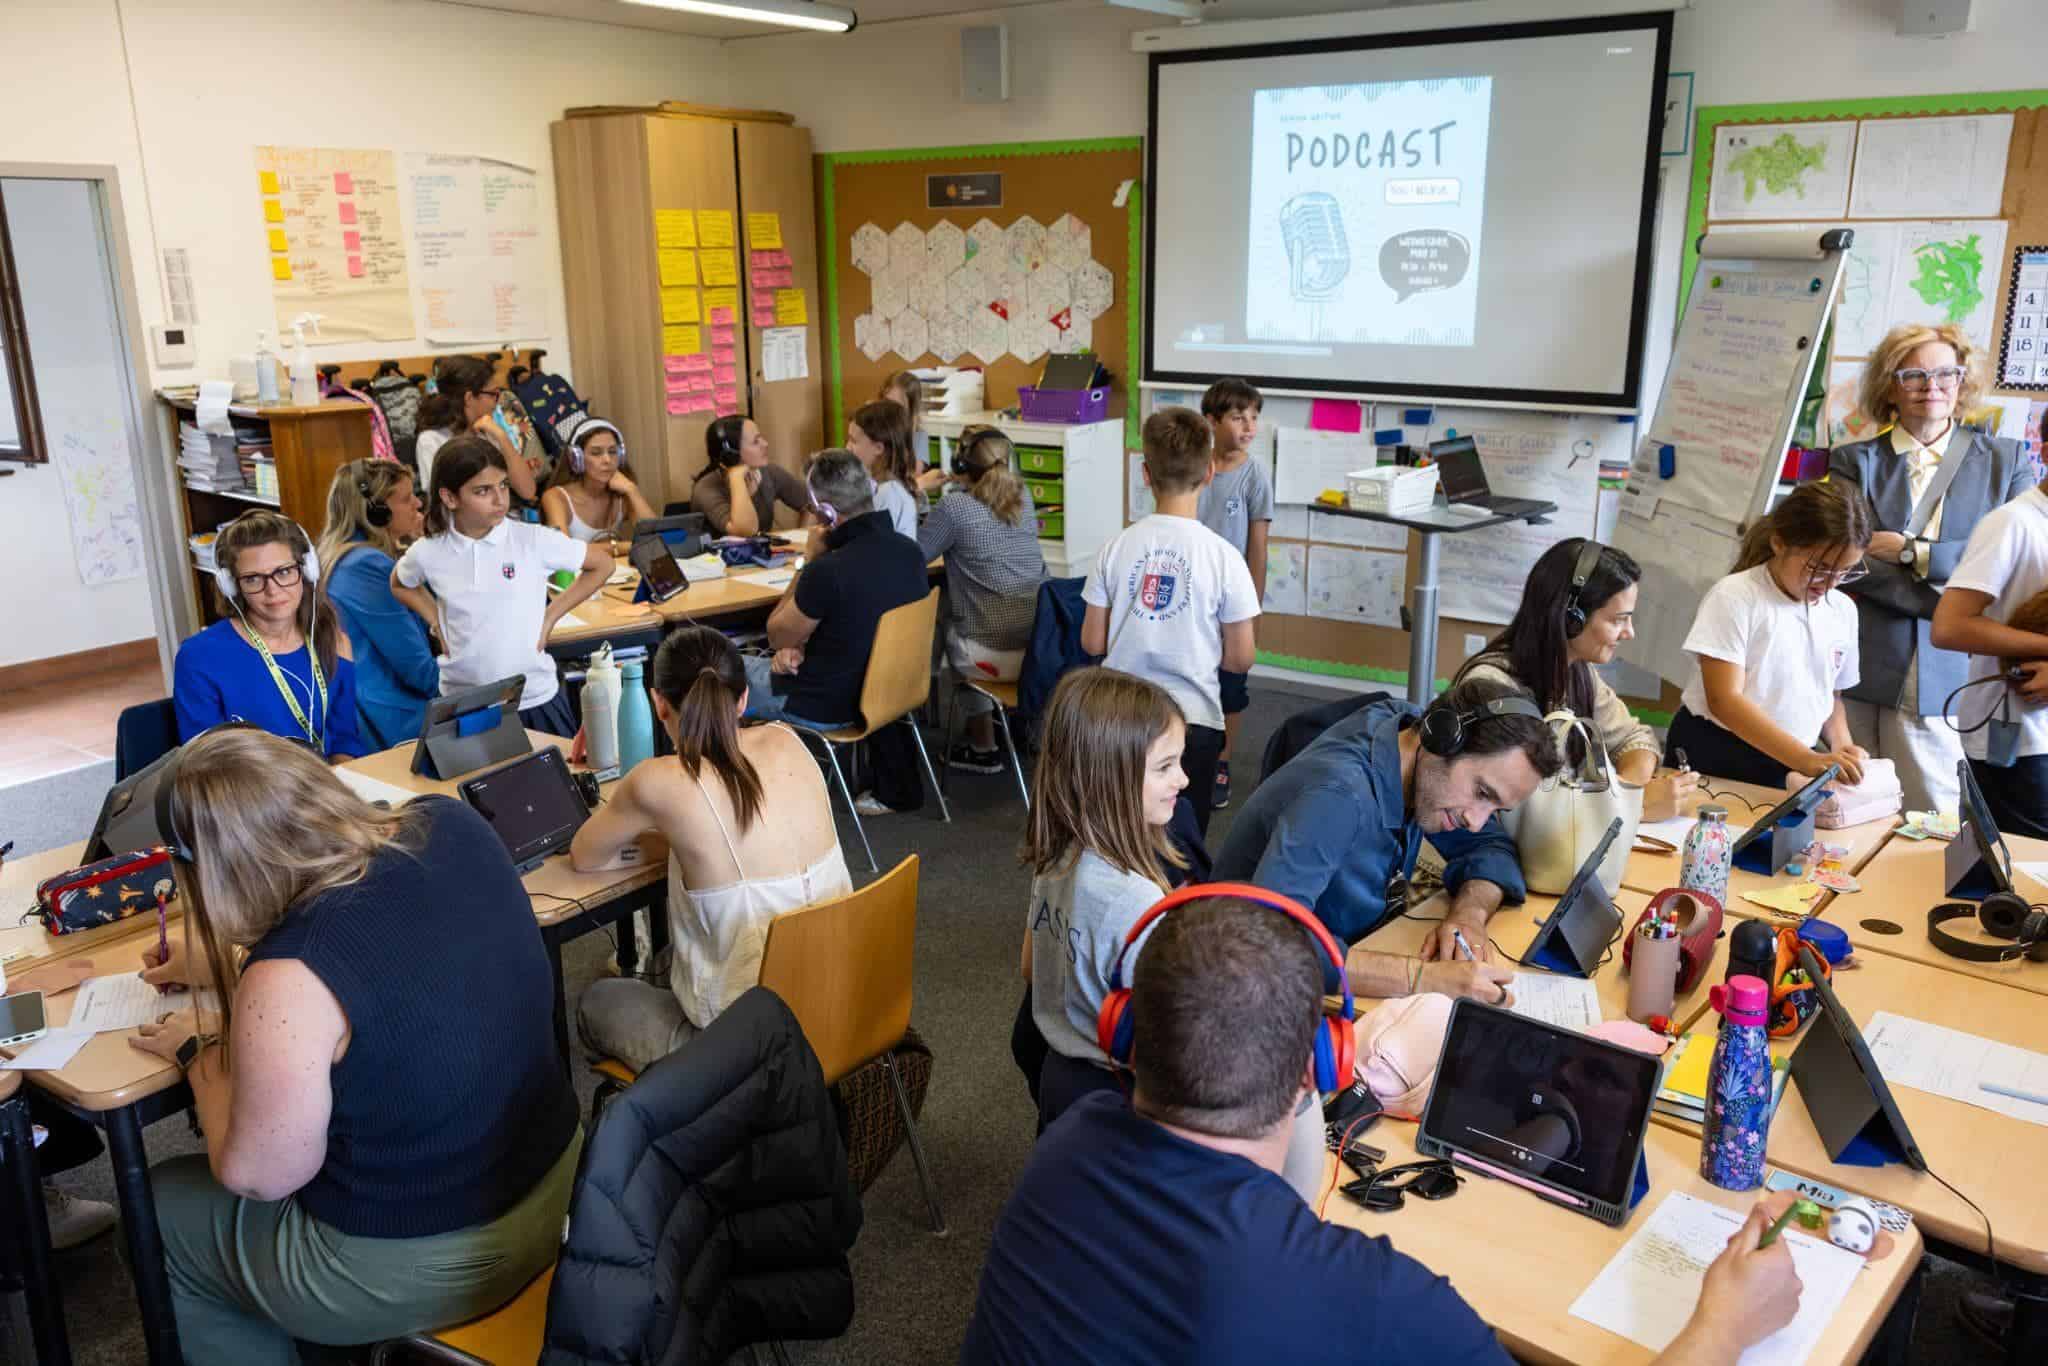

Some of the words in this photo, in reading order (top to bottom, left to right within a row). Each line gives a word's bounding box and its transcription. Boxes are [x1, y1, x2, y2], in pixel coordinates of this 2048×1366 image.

[1286, 120, 1457, 173] PODCAST
[2025, 292, 2035, 305] 4
[2020, 315, 2032, 329] 11
[2015, 338, 2033, 351] 18
[1796, 1182, 1834, 1202] Mia
